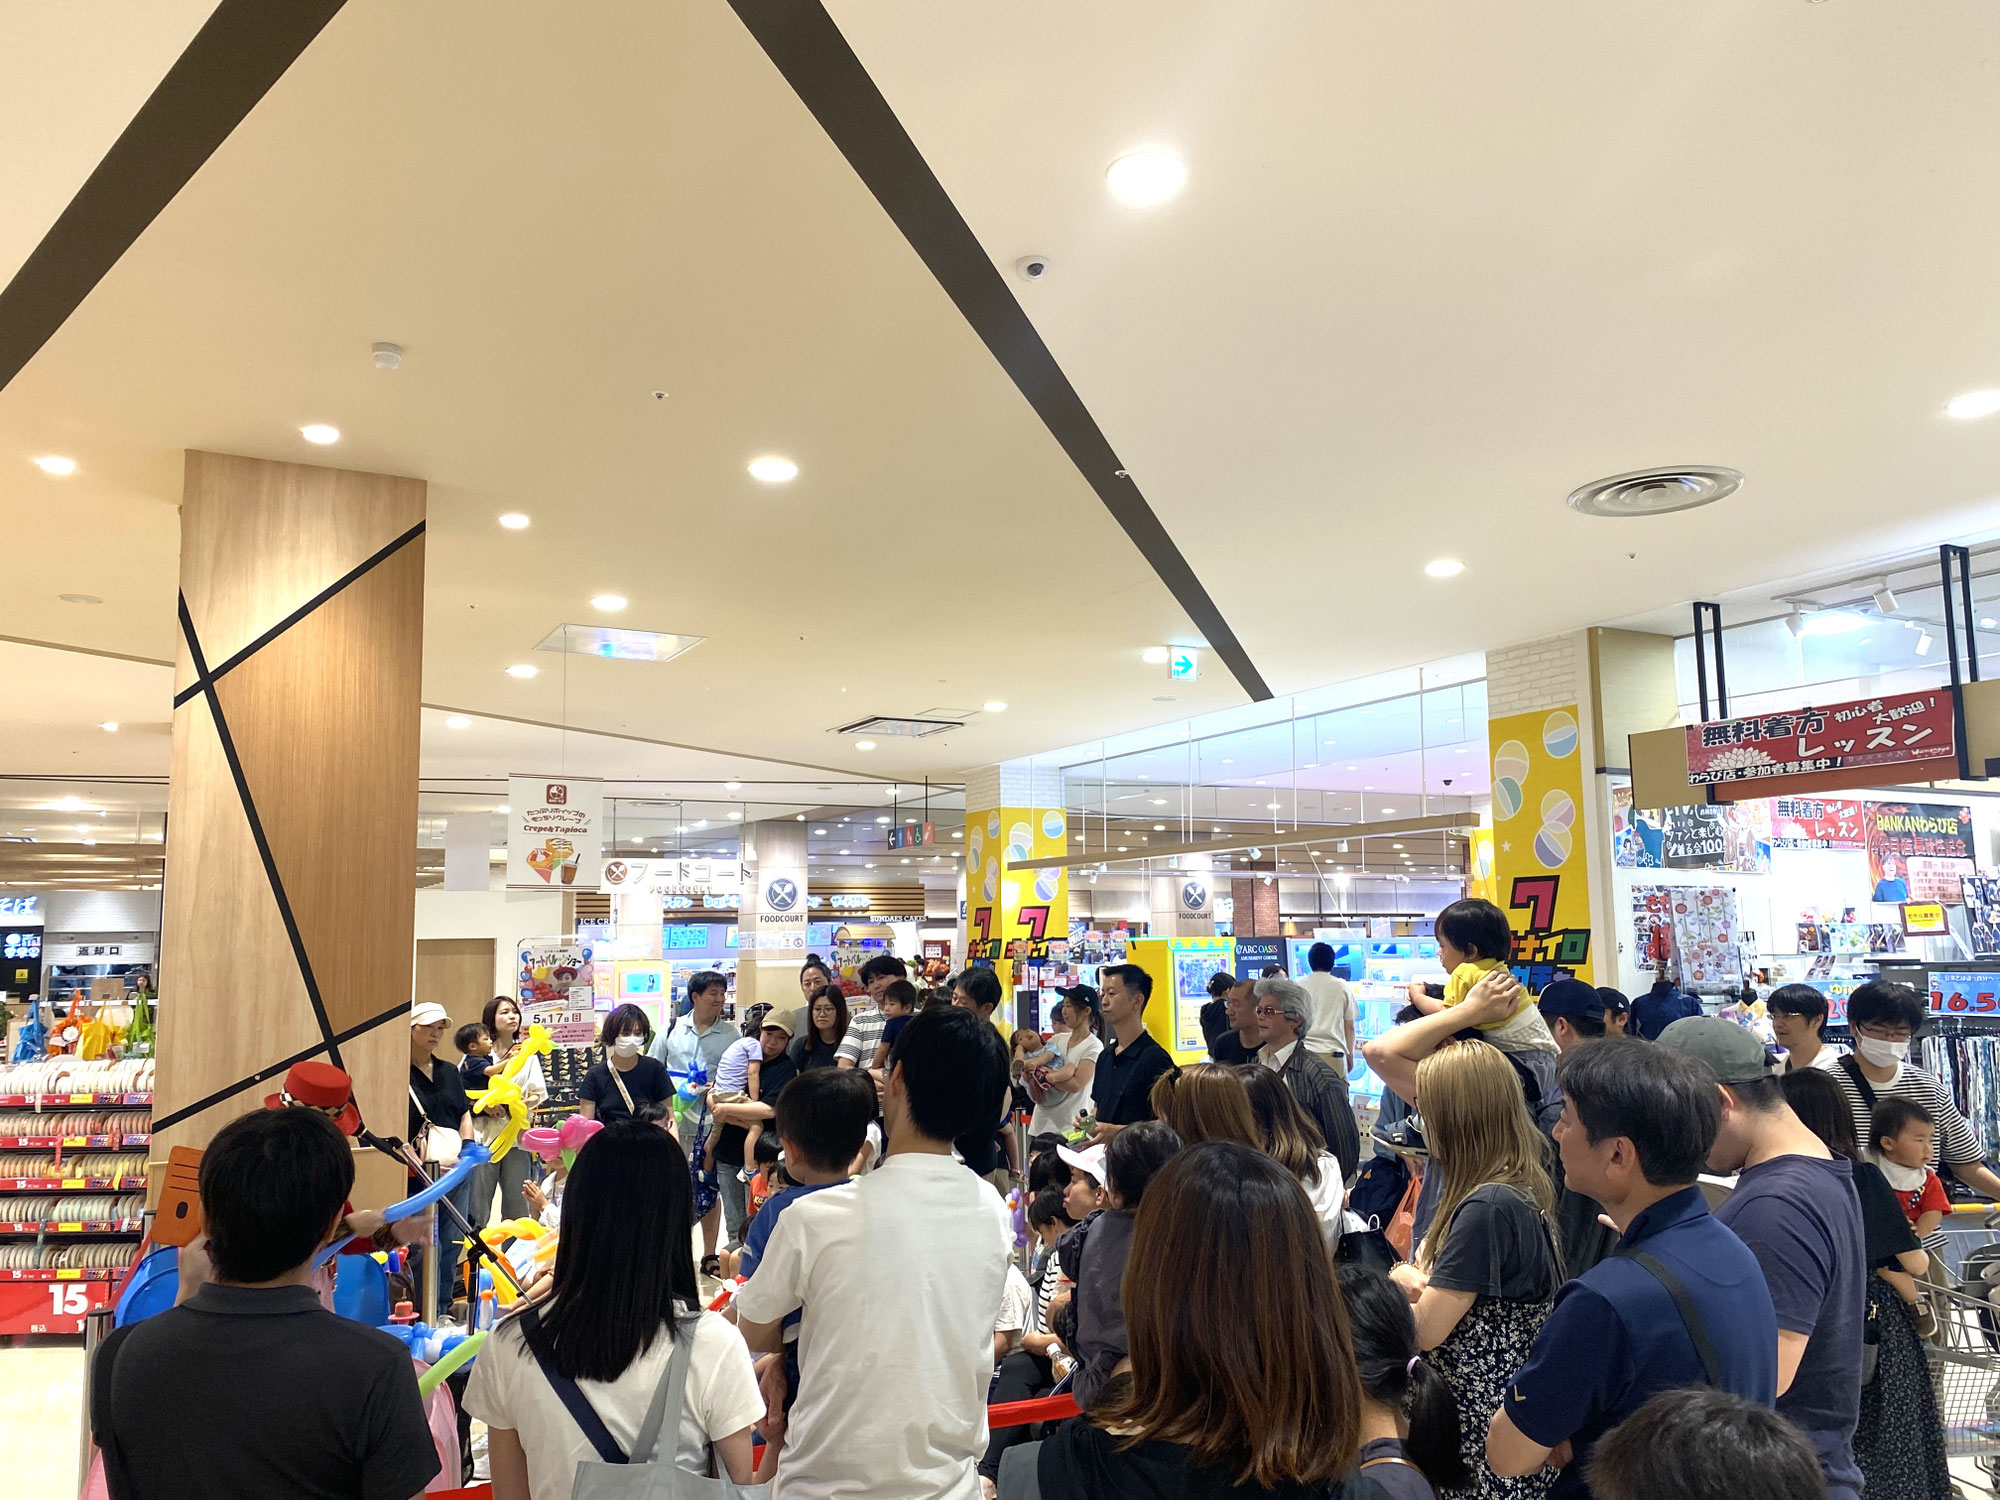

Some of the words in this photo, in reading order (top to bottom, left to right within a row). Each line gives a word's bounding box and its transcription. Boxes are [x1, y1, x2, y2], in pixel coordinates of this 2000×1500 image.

[1834, 700, 1883, 723] 初心者
[1872, 697, 1936, 725] 大歓迎！
[1703, 710, 1829, 747] 無料着方
[1797, 723, 1934, 758] レッスン
[1689, 756, 1842, 784] わらび店・参加者募集中！
[1778, 800, 1824, 820] 無料着方
[523, 824, 588, 834] Crepe&Tapioca
[1815, 820, 1859, 838] レッスン
[1876, 814, 1959, 835] BANKANわらび店
[630, 861, 753, 885] フードコート
[760, 915, 804, 923] FOODCOURT
[1179, 912, 1212, 920] FOODCOURT
[78, 947, 120, 956] 返却口
[1242, 945, 1258, 954] ARC
[1258, 945, 1278, 953] OASIS
[1930, 991, 2000, 1012] 16.5
[533, 1013, 569, 1023] 5月17日
[25, 1095, 34, 1103] 15
[18, 1138, 28, 1146] 15
[16, 1180, 26, 1189] 15
[13, 1223, 23, 1232] 15
[12, 1270, 21, 1279] 15
[48, 1284, 88, 1315] 15
[31, 1324, 46, 1332] 税込
